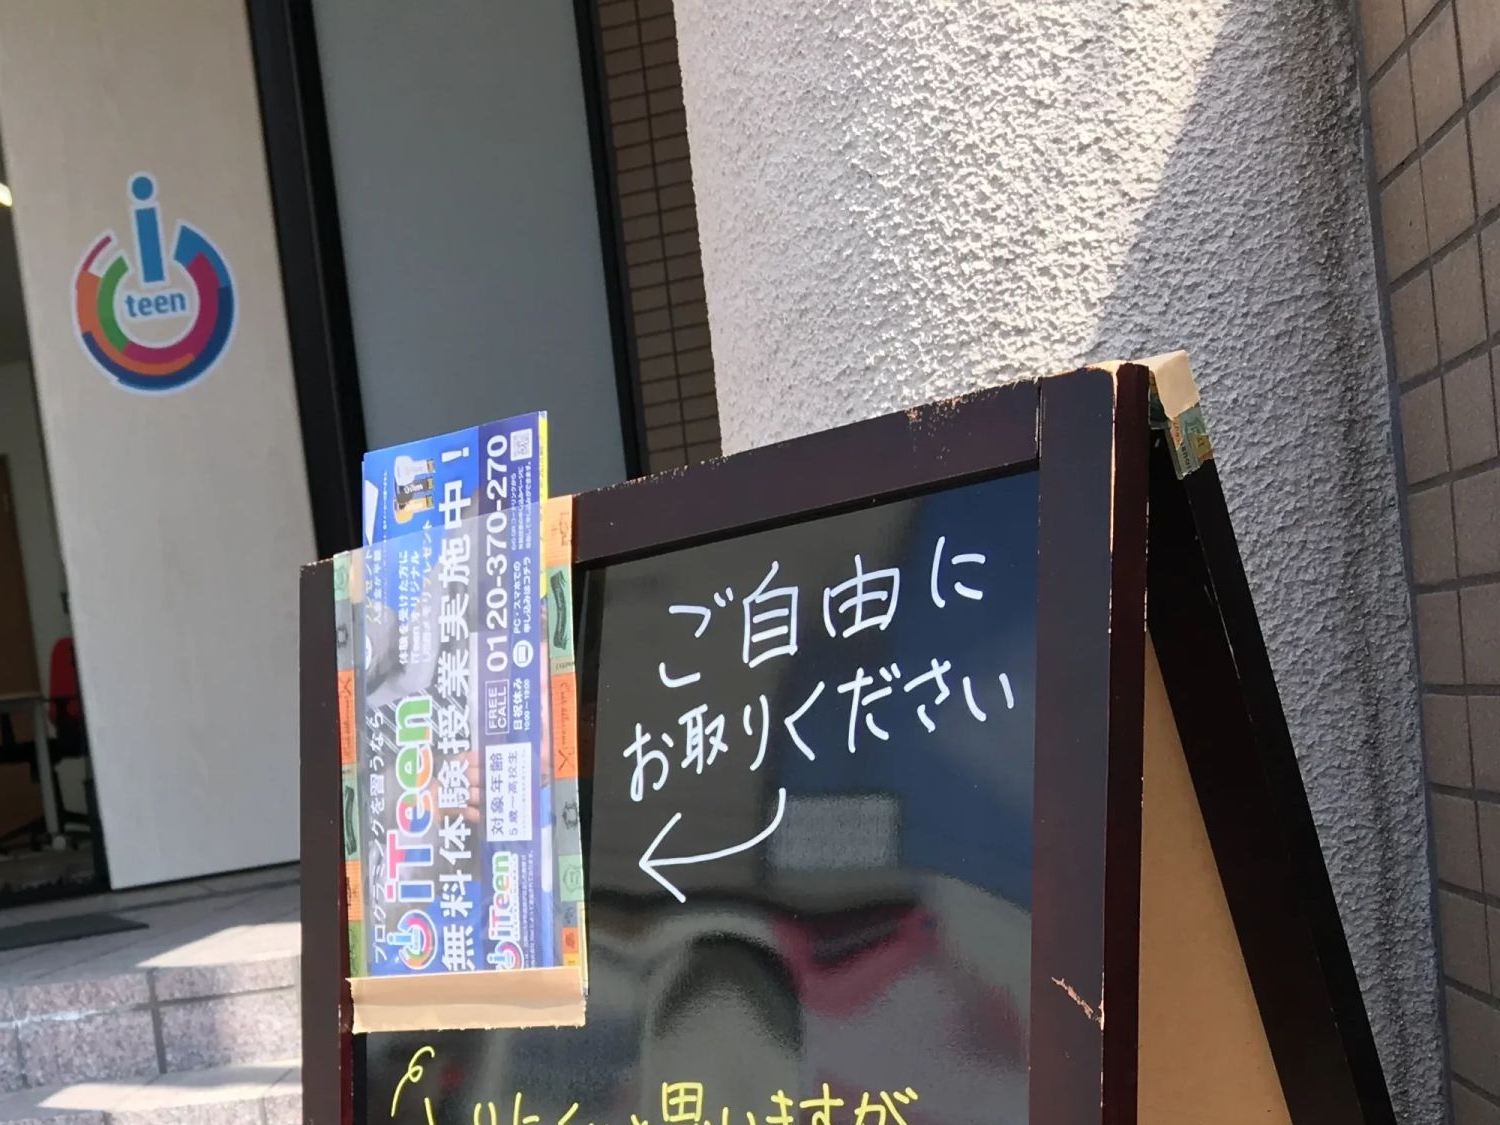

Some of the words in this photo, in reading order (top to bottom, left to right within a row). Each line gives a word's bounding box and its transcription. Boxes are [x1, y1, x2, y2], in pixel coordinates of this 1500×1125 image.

[125, 292, 187, 318] teen
[487, 435, 508, 672] 0120-370-270
[658, 536, 987, 688] ご自由に
[488, 687, 498, 729] FREE
[498, 685, 507, 728] CALL
[513, 678, 522, 731] 日祝休み
[623, 658, 1015, 802] お取りください
[365, 711, 388, 963] プログラミングを習うなら
[384, 694, 435, 903] iTeen
[491, 752, 504, 835] 対象年齢
[490, 852, 511, 939] iTeen
